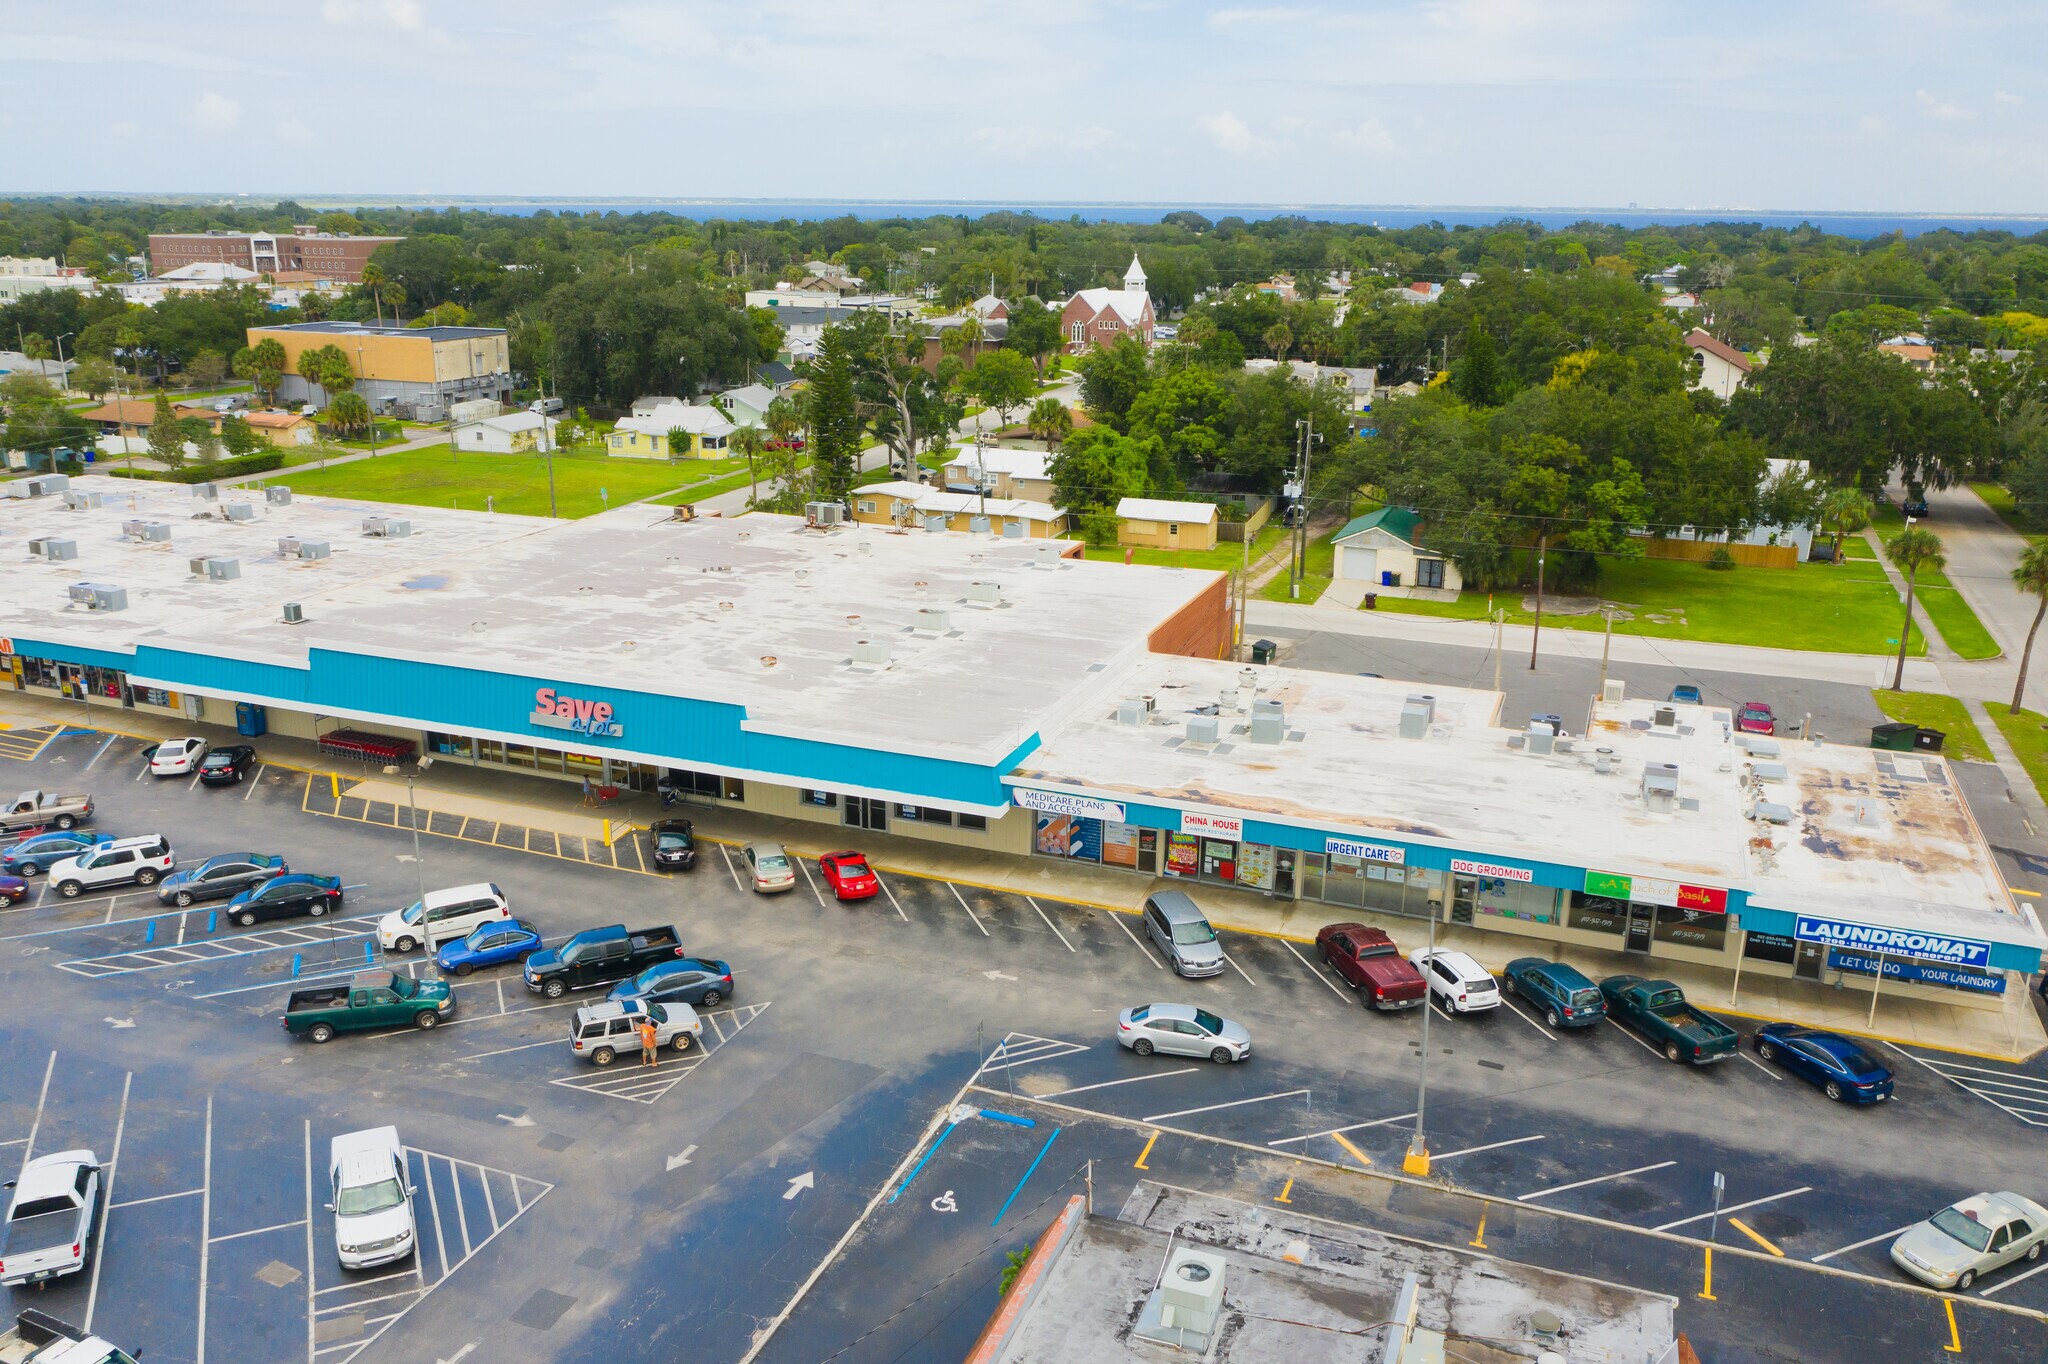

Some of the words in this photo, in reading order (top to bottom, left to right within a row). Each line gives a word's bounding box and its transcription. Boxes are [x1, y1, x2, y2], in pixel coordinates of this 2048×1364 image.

[535, 687, 614, 723] Save
[1025, 791, 1073, 806] MEDICARE
[1075, 799, 1106, 811] PLANS
[1025, 800, 1046, 810] AND
[1047, 803, 1082, 815] ACCESS
[1184, 815, 1208, 826] CHINA
[1212, 819, 1240, 831] HOUSE
[1207, 829, 1238, 837] RESTAURANT
[1327, 841, 1364, 857] URGENT
[1365, 847, 1390, 861] CARE
[1453, 861, 1473, 872] DOG
[1477, 864, 1530, 881] GROOMING
[1607, 879, 1618, 889] A
[1620, 880, 1655, 894] Touch
[1658, 884, 1673, 896] of
[1676, 888, 1705, 901] Basil
[1799, 921, 1987, 960] LAUNDROMAT
[1850, 941, 1874, 950] SELF
[1876, 945, 1910, 955] SERVE
[1914, 951, 1963, 962] DROPOFF
[1839, 955, 1862, 968] LET
[1864, 960, 1880, 971] US
[1883, 962, 1900, 974] DO
[1921, 968, 1948, 981] YOUR
[1950, 973, 1999, 989] LAUNDRY
